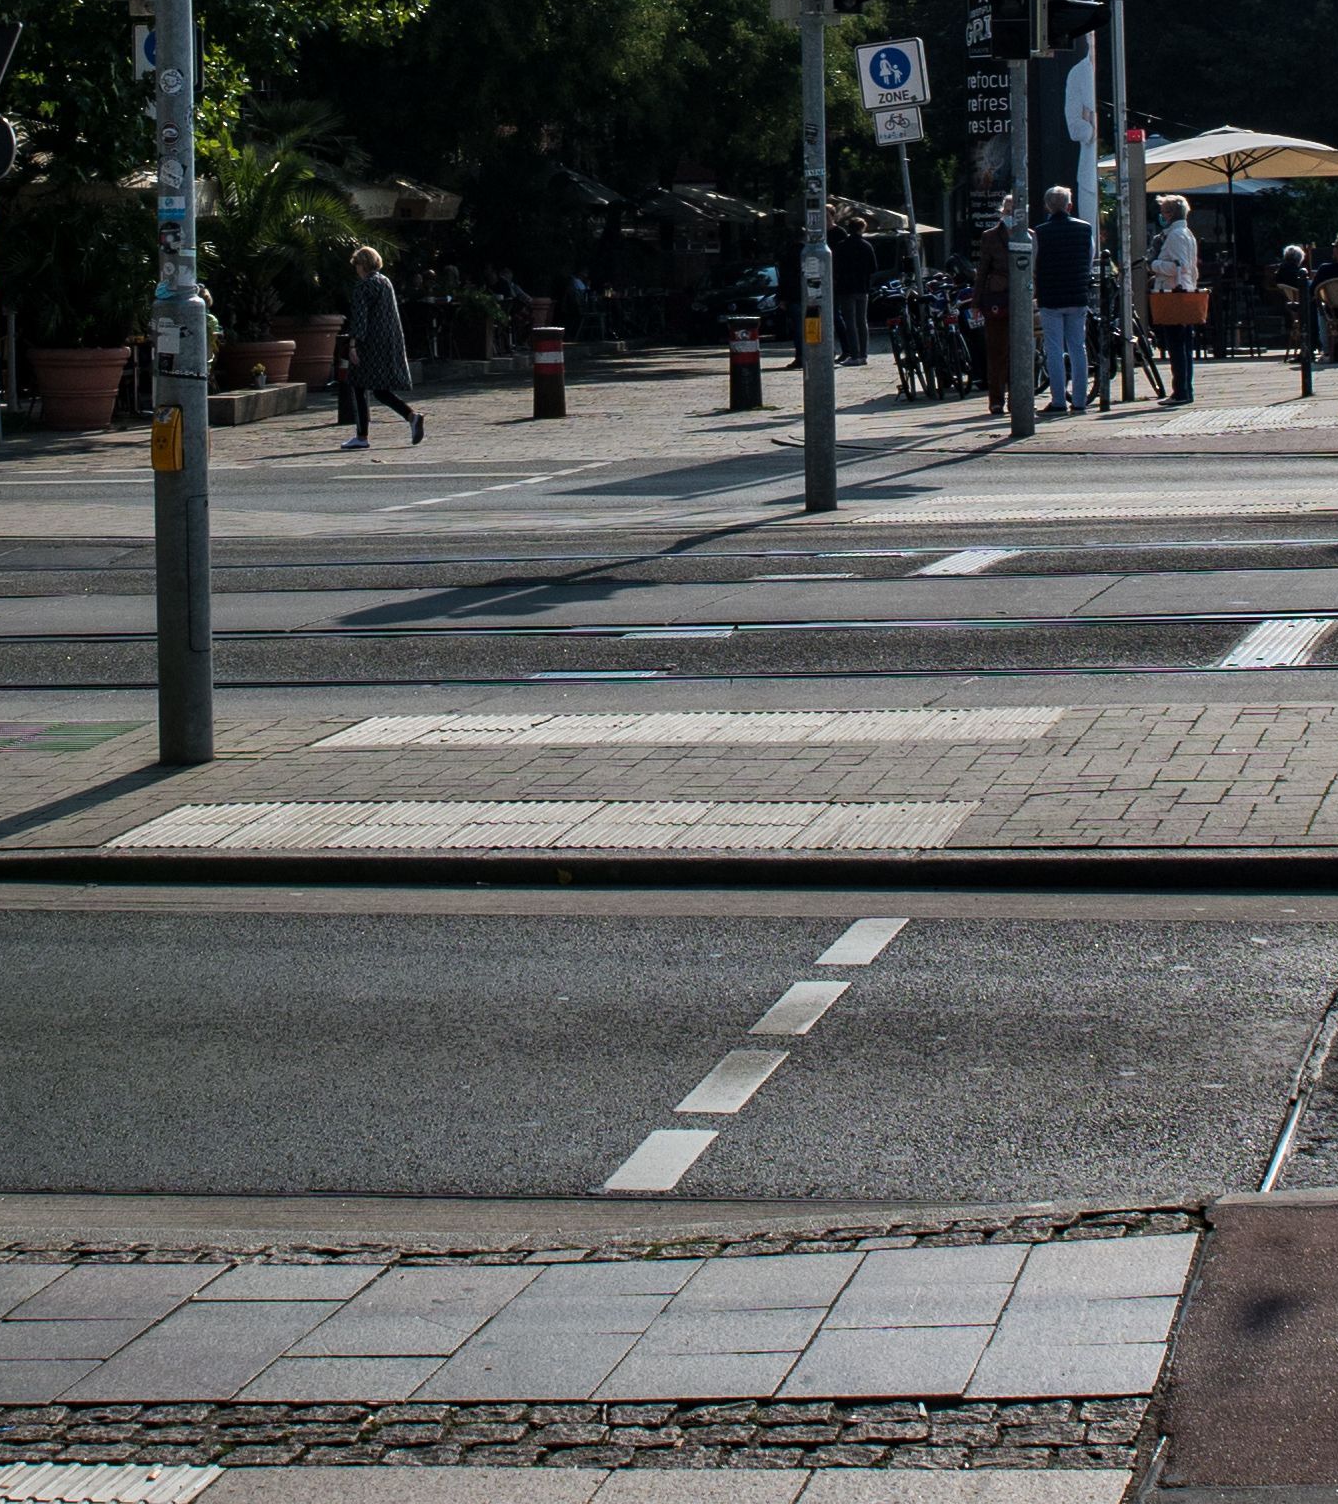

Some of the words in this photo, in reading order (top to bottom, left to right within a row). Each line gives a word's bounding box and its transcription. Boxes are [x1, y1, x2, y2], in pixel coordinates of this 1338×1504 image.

[966, 14, 992, 47] GRI
[967, 70, 1011, 88] refocu
[878, 90, 910, 104] ZONE
[967, 116, 1012, 134] restar
